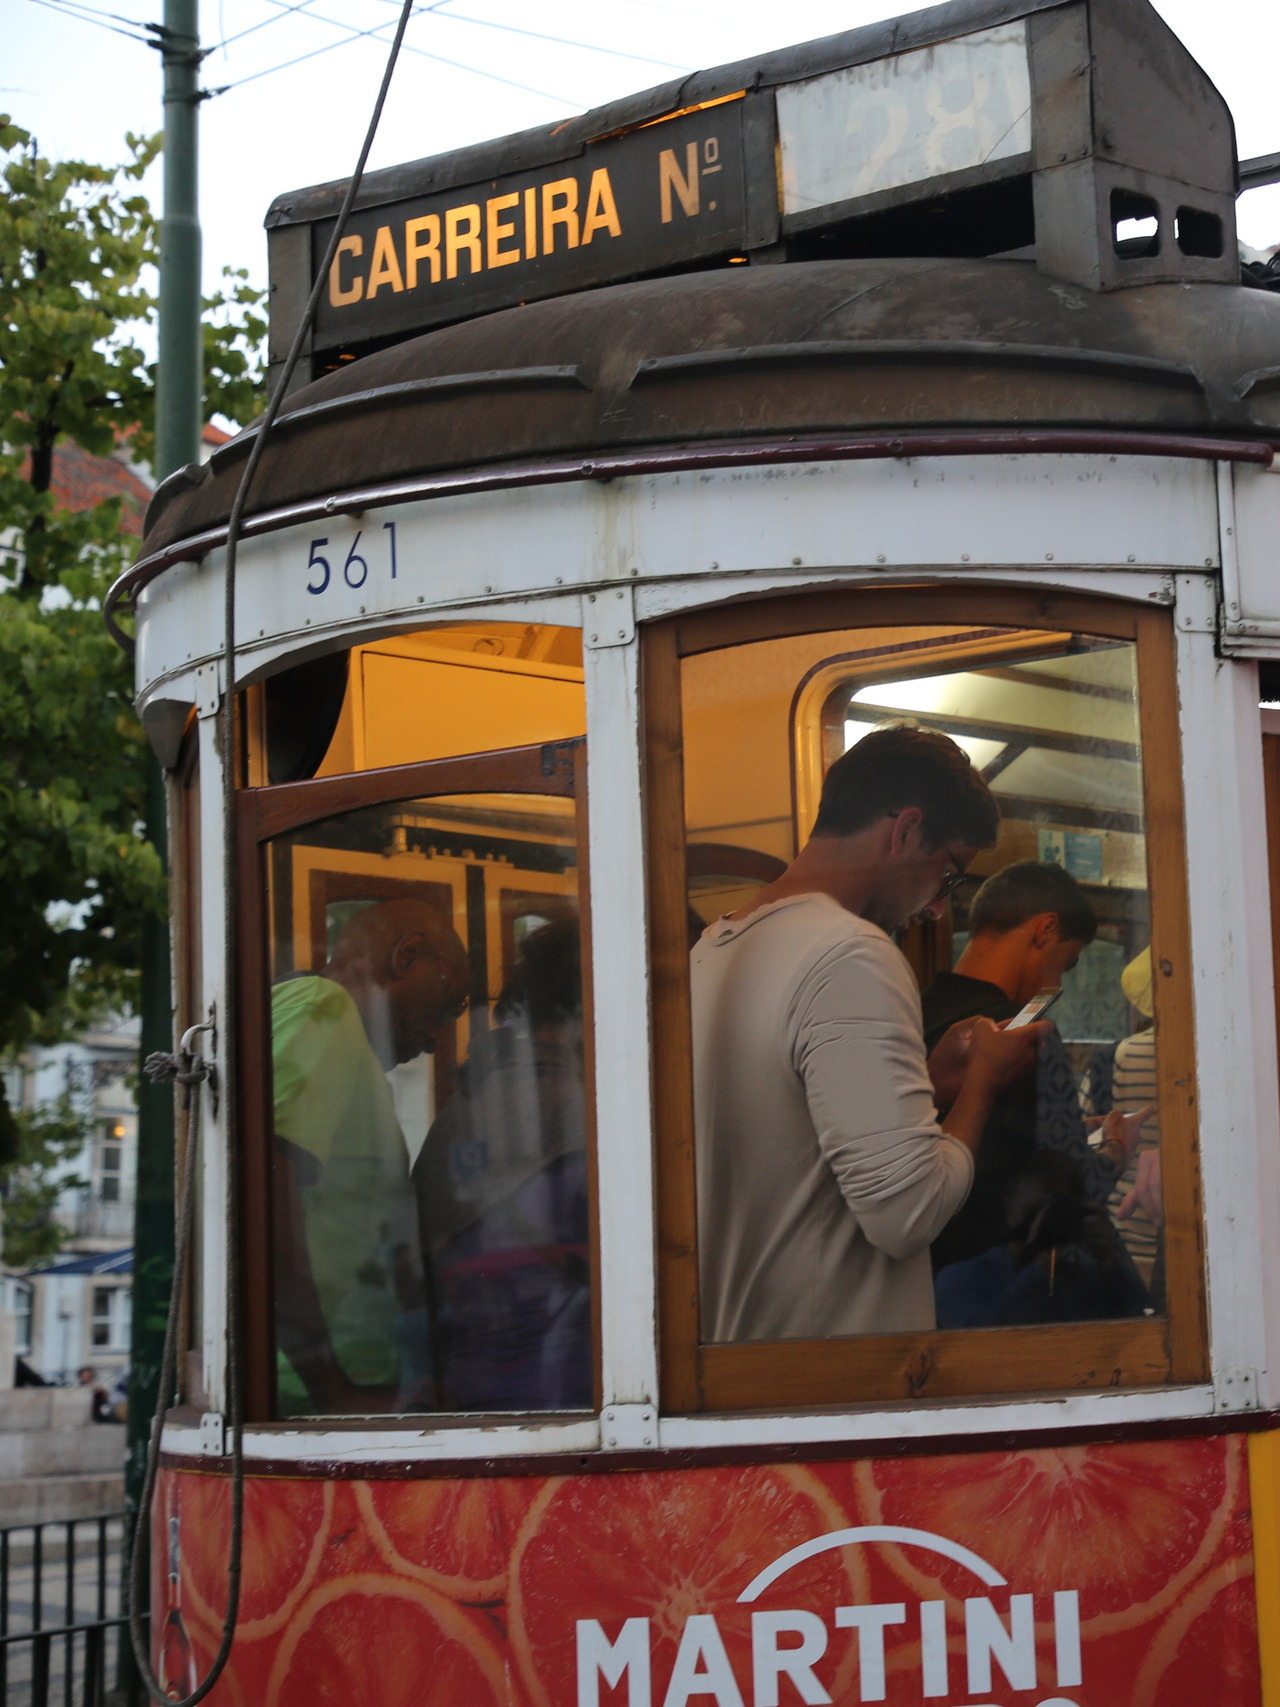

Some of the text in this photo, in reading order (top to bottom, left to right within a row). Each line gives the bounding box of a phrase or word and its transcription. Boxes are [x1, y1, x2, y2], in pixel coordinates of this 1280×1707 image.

[328, 166, 623, 308] CARREIRA
[305, 520, 401, 595] 561
[576, 1589, 1083, 1707] MARTINI
